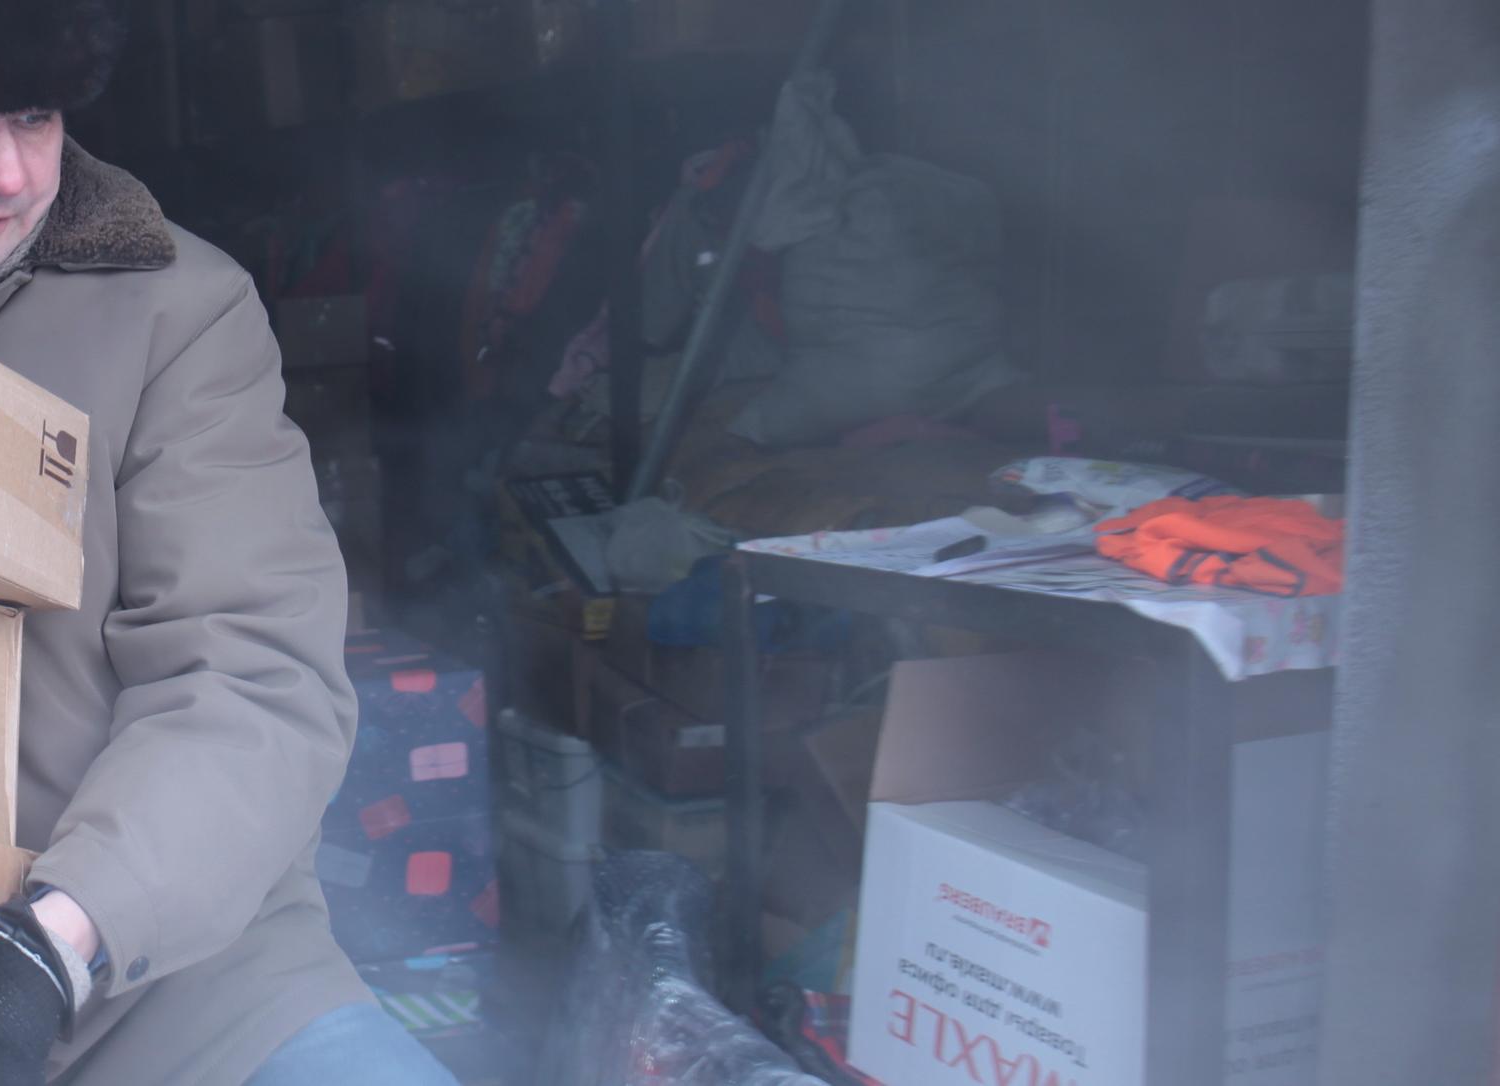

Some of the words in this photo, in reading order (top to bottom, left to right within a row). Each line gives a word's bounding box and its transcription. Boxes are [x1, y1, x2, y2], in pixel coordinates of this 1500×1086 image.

[897, 957, 960, 999] офиса
[924, 941, 1063, 1018] www.maxle.ru
[961, 990, 1002, 1019] для
[1004, 1011, 1090, 1069] Товары
